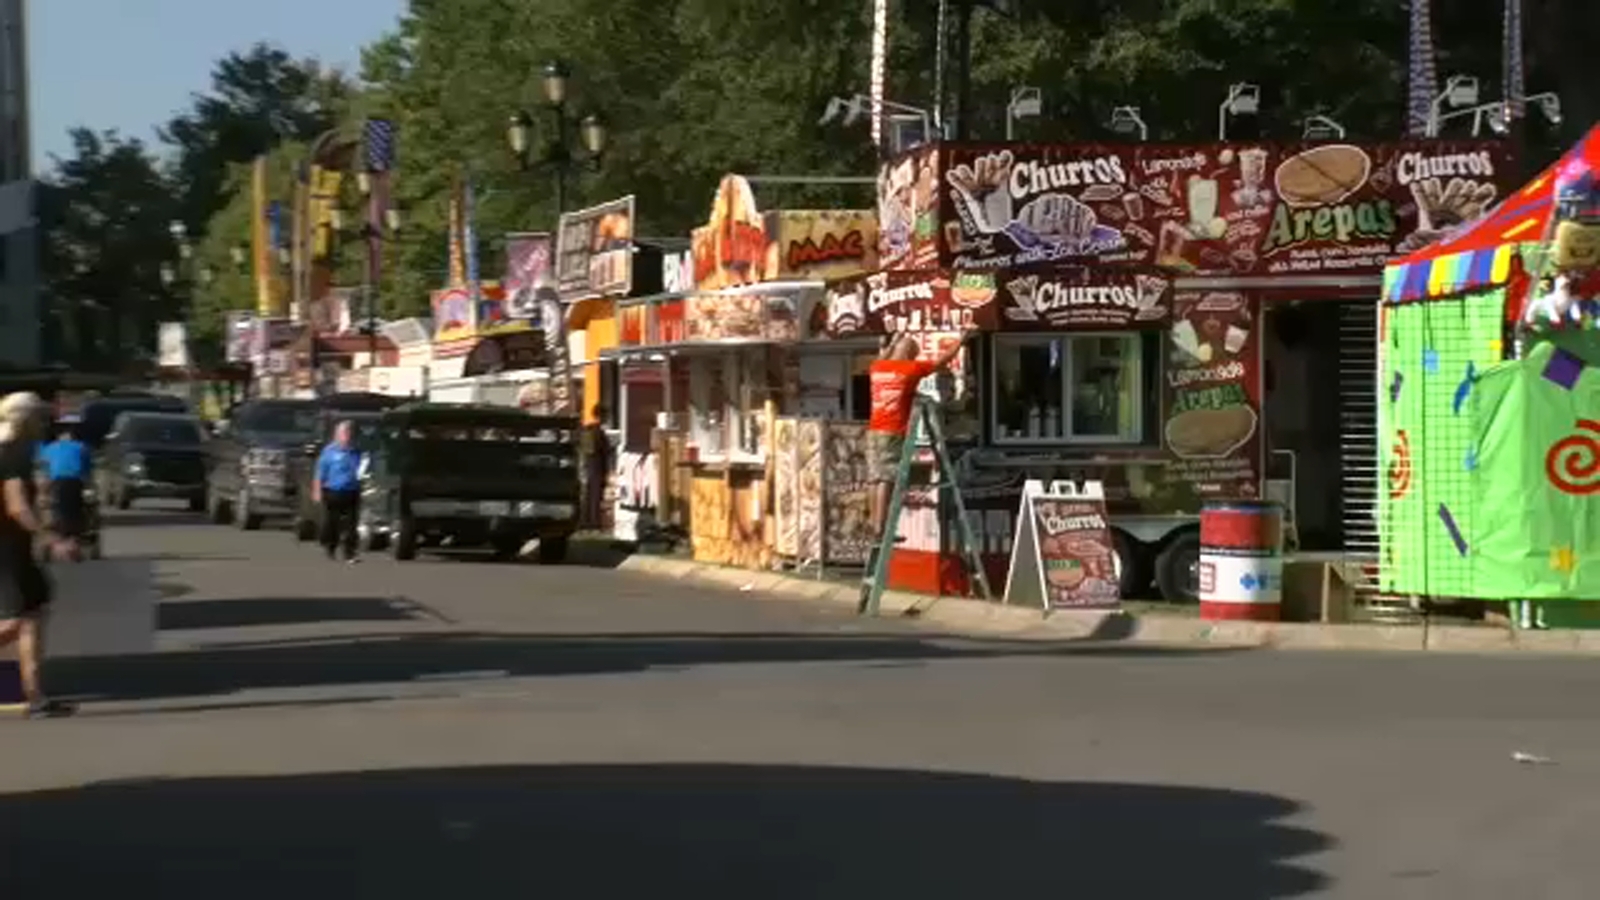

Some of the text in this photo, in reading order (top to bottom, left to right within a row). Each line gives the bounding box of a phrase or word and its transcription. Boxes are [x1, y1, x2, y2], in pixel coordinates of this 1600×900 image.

[1010, 155, 1126, 198] Churros
[1398, 151, 1493, 184] Churros
[1263, 201, 1397, 250] Arepas
[788, 229, 863, 271] MAC
[868, 282, 933, 313] Churros
[1036, 281, 1138, 313] Churros
[1167, 361, 1245, 387] Lemonade
